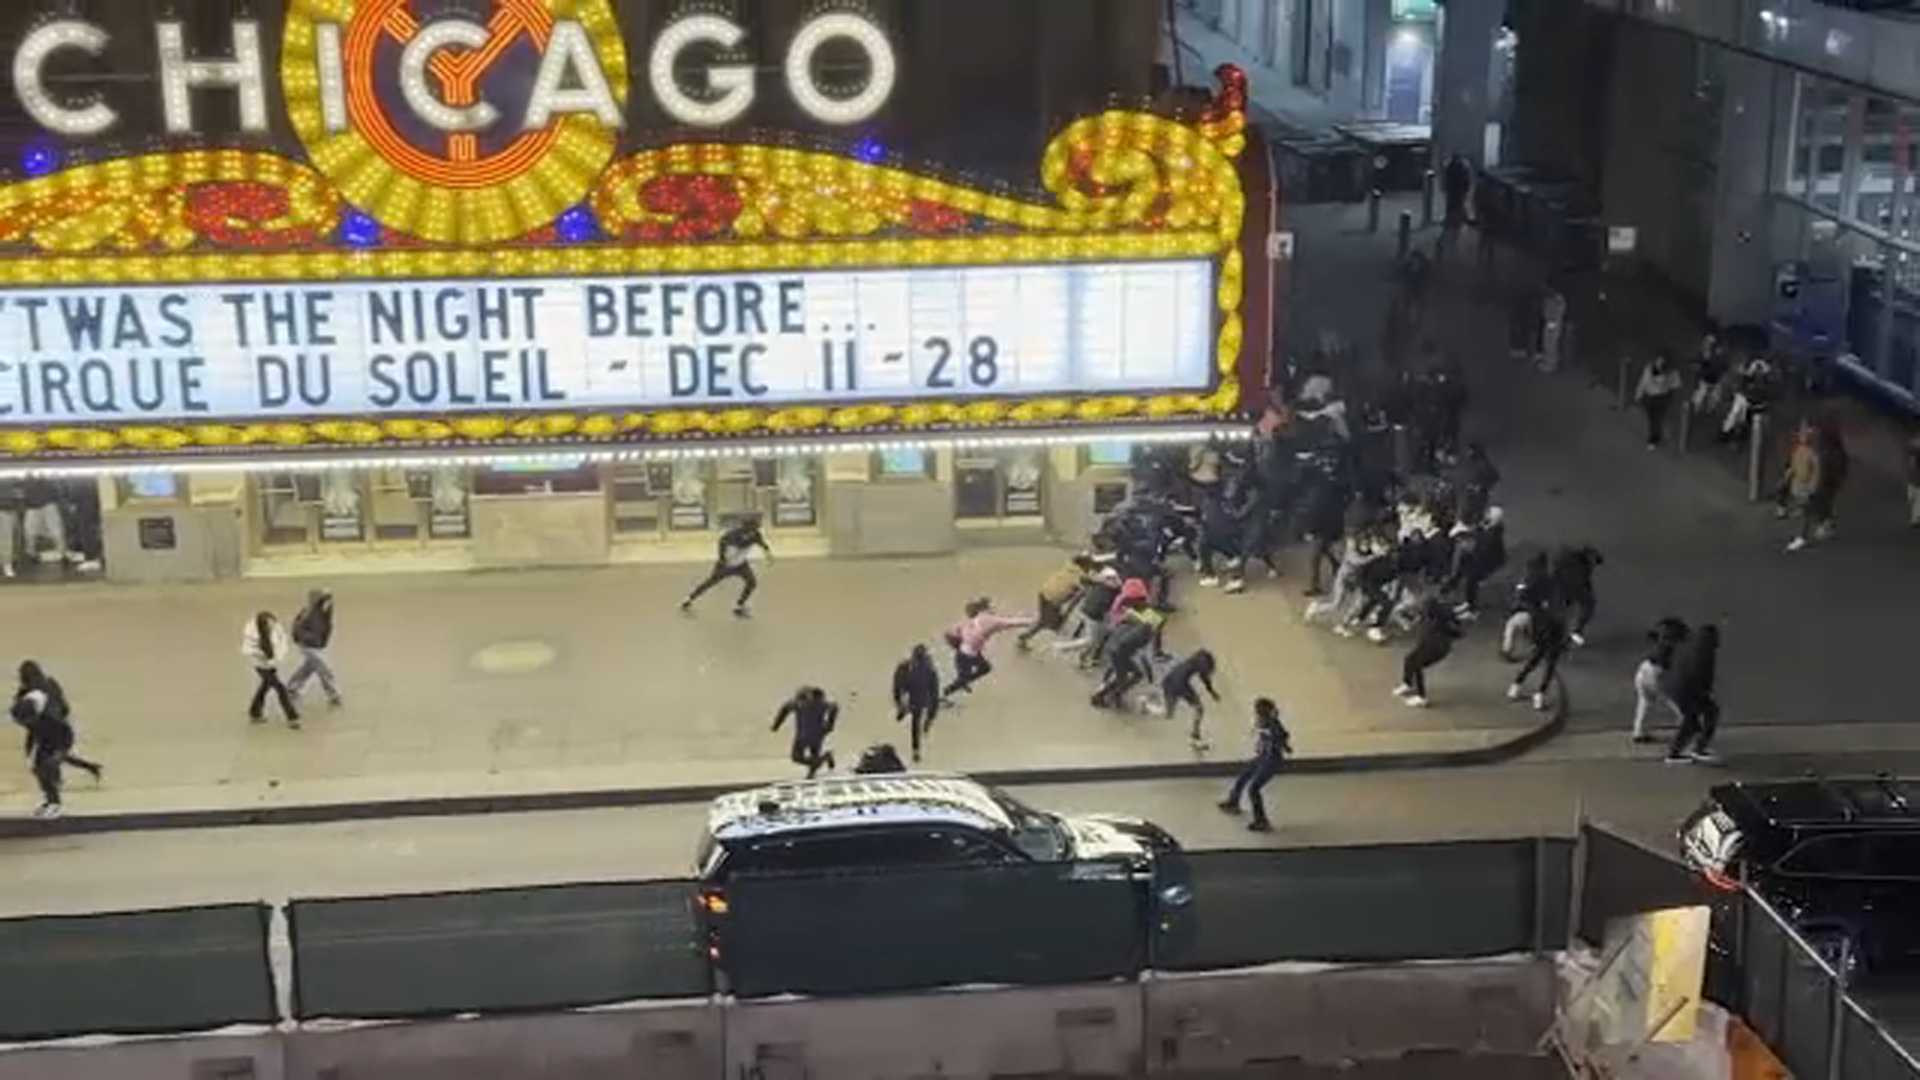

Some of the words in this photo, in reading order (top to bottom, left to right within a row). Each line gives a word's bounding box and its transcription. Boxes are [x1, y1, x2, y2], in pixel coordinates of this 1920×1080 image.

[13, 13, 896, 135] CHICAGO
[221, 290, 336, 347] THE
[367, 287, 544, 344] NIGHT
[257, 353, 331, 408] DU
[367, 349, 566, 407] SOLEIL
[668, 343, 769, 397] DEC
